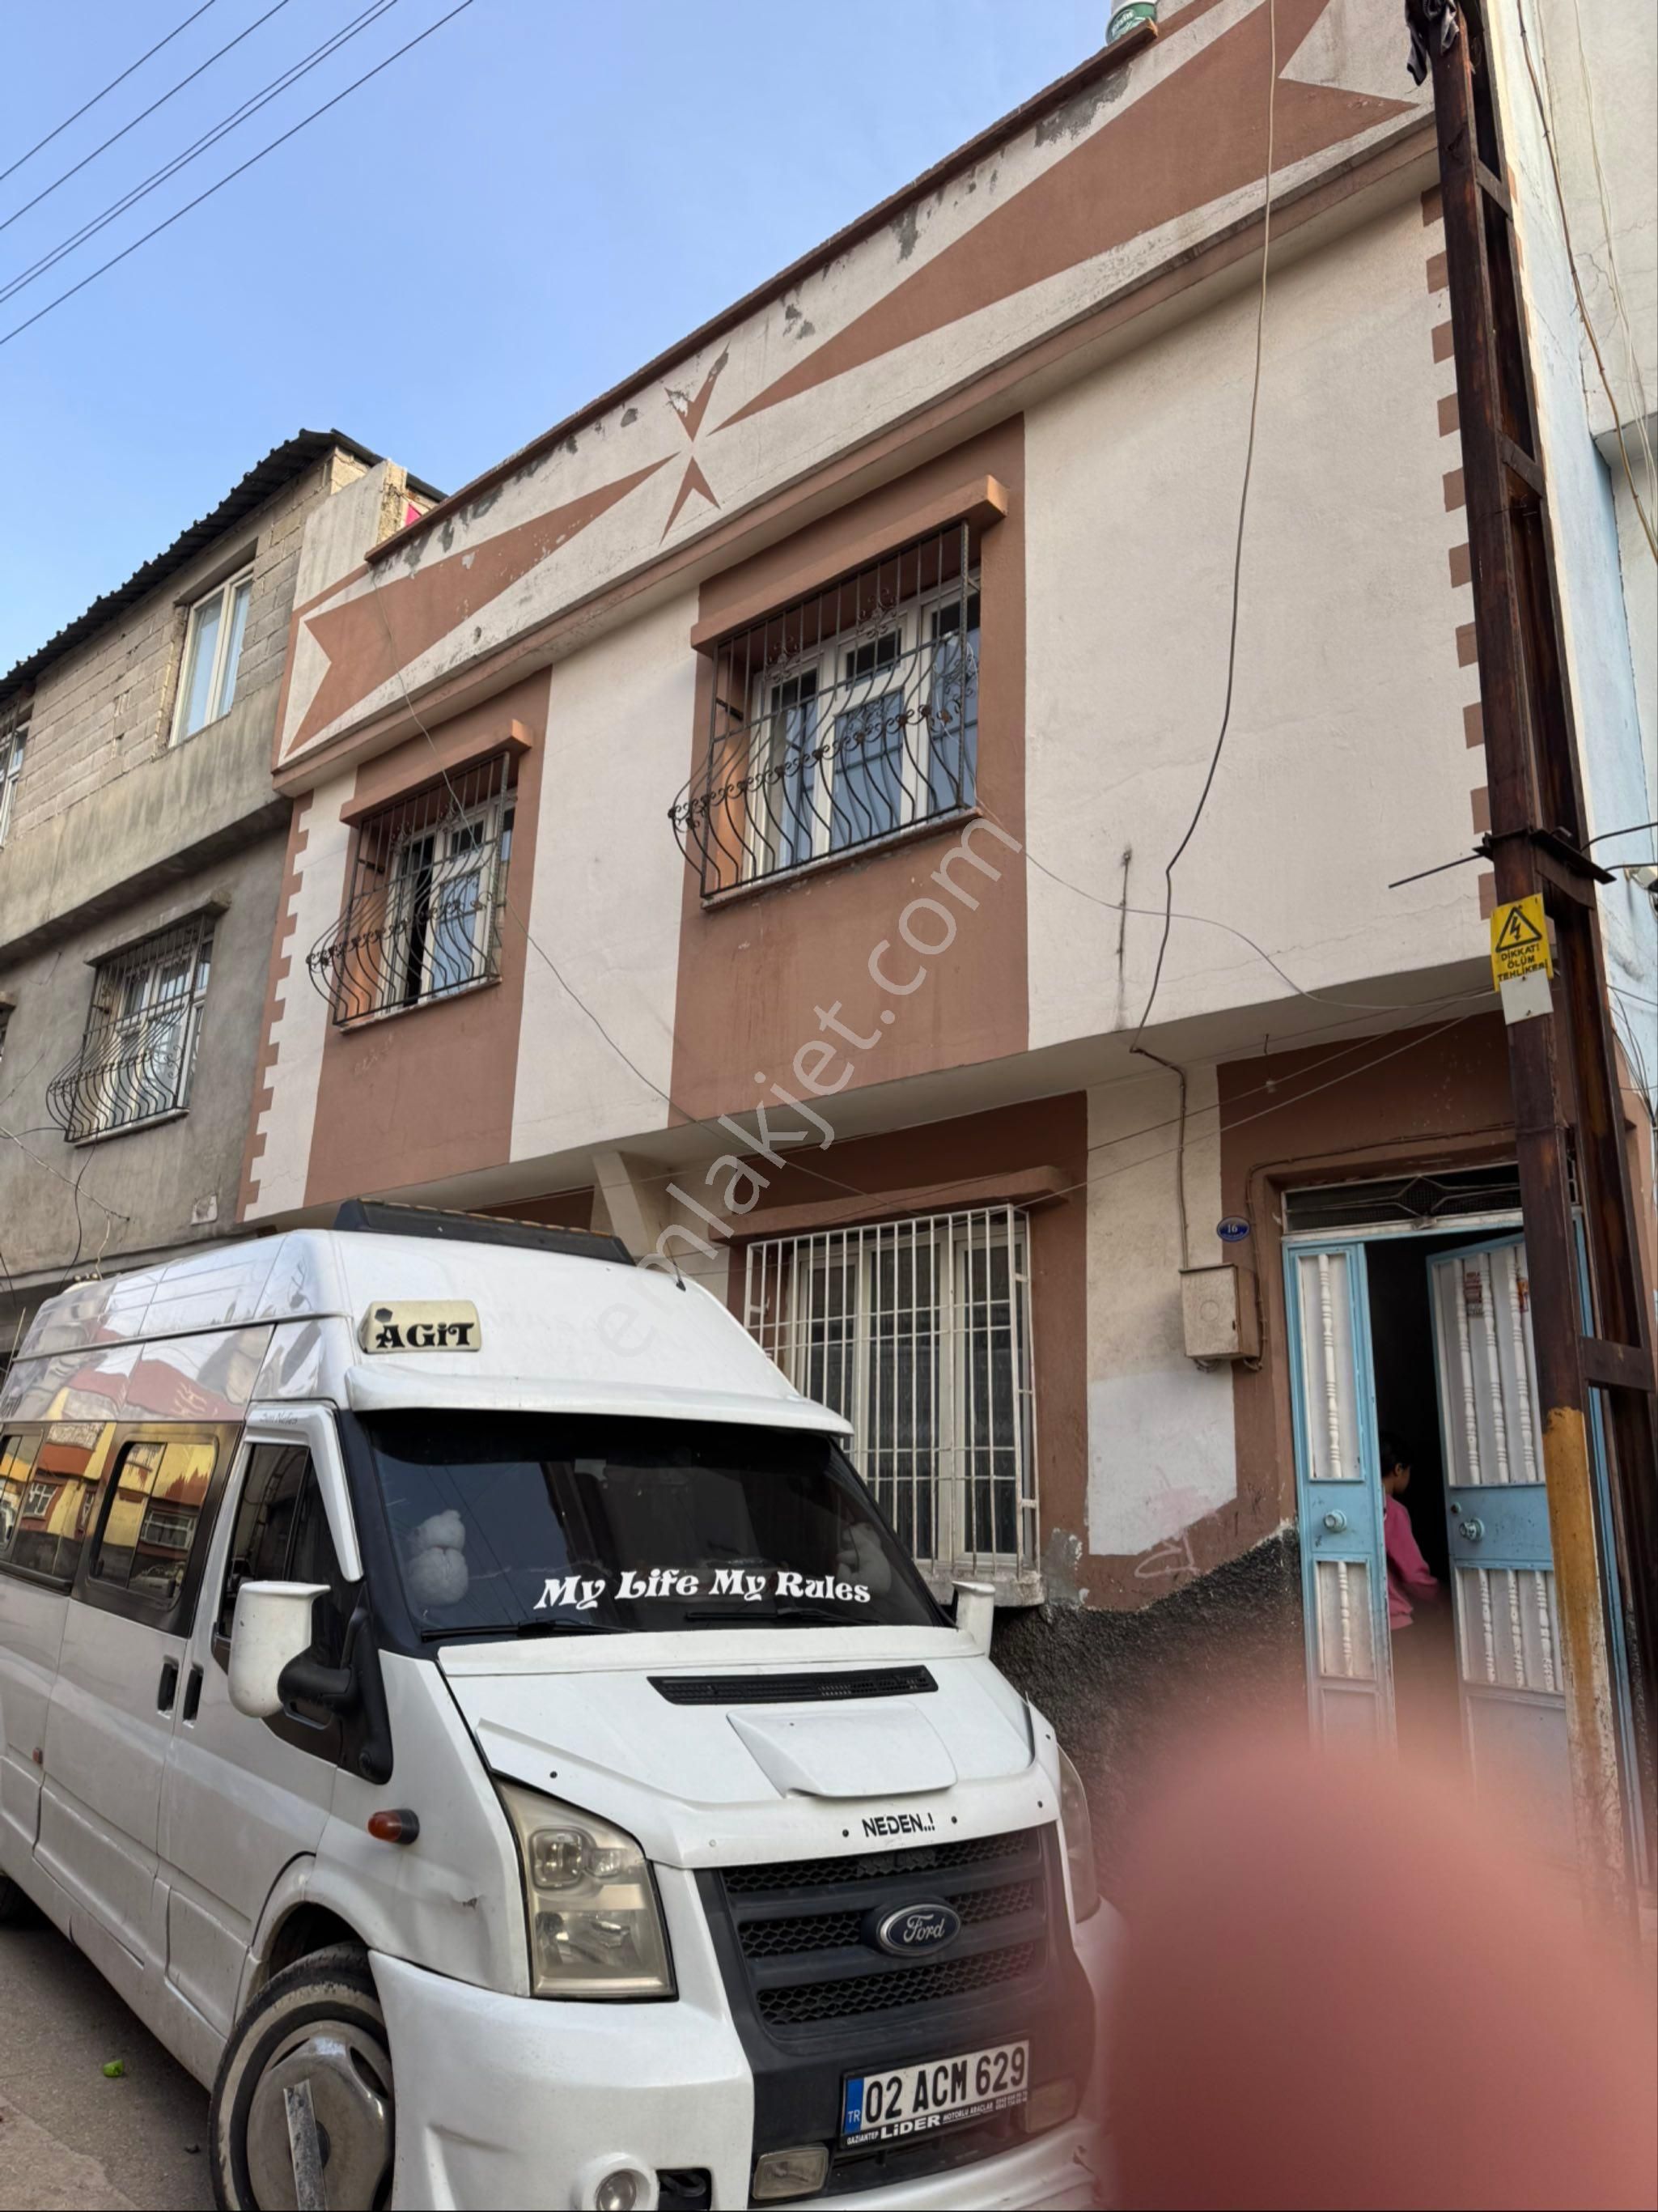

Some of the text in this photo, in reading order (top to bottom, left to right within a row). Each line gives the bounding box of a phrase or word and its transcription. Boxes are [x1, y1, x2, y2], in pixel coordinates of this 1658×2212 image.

[1507, 954, 1535, 970] ÖLÜM
[532, 1568, 871, 1610] My Life My Rules
[861, 1812, 936, 1838] NEDEN..!
[902, 1914, 946, 1942] Ford
[847, 2109, 861, 2125] TR
[865, 2076, 903, 2124] 02
[912, 2060, 968, 2113] ACM
[975, 2045, 1025, 2096] 629
